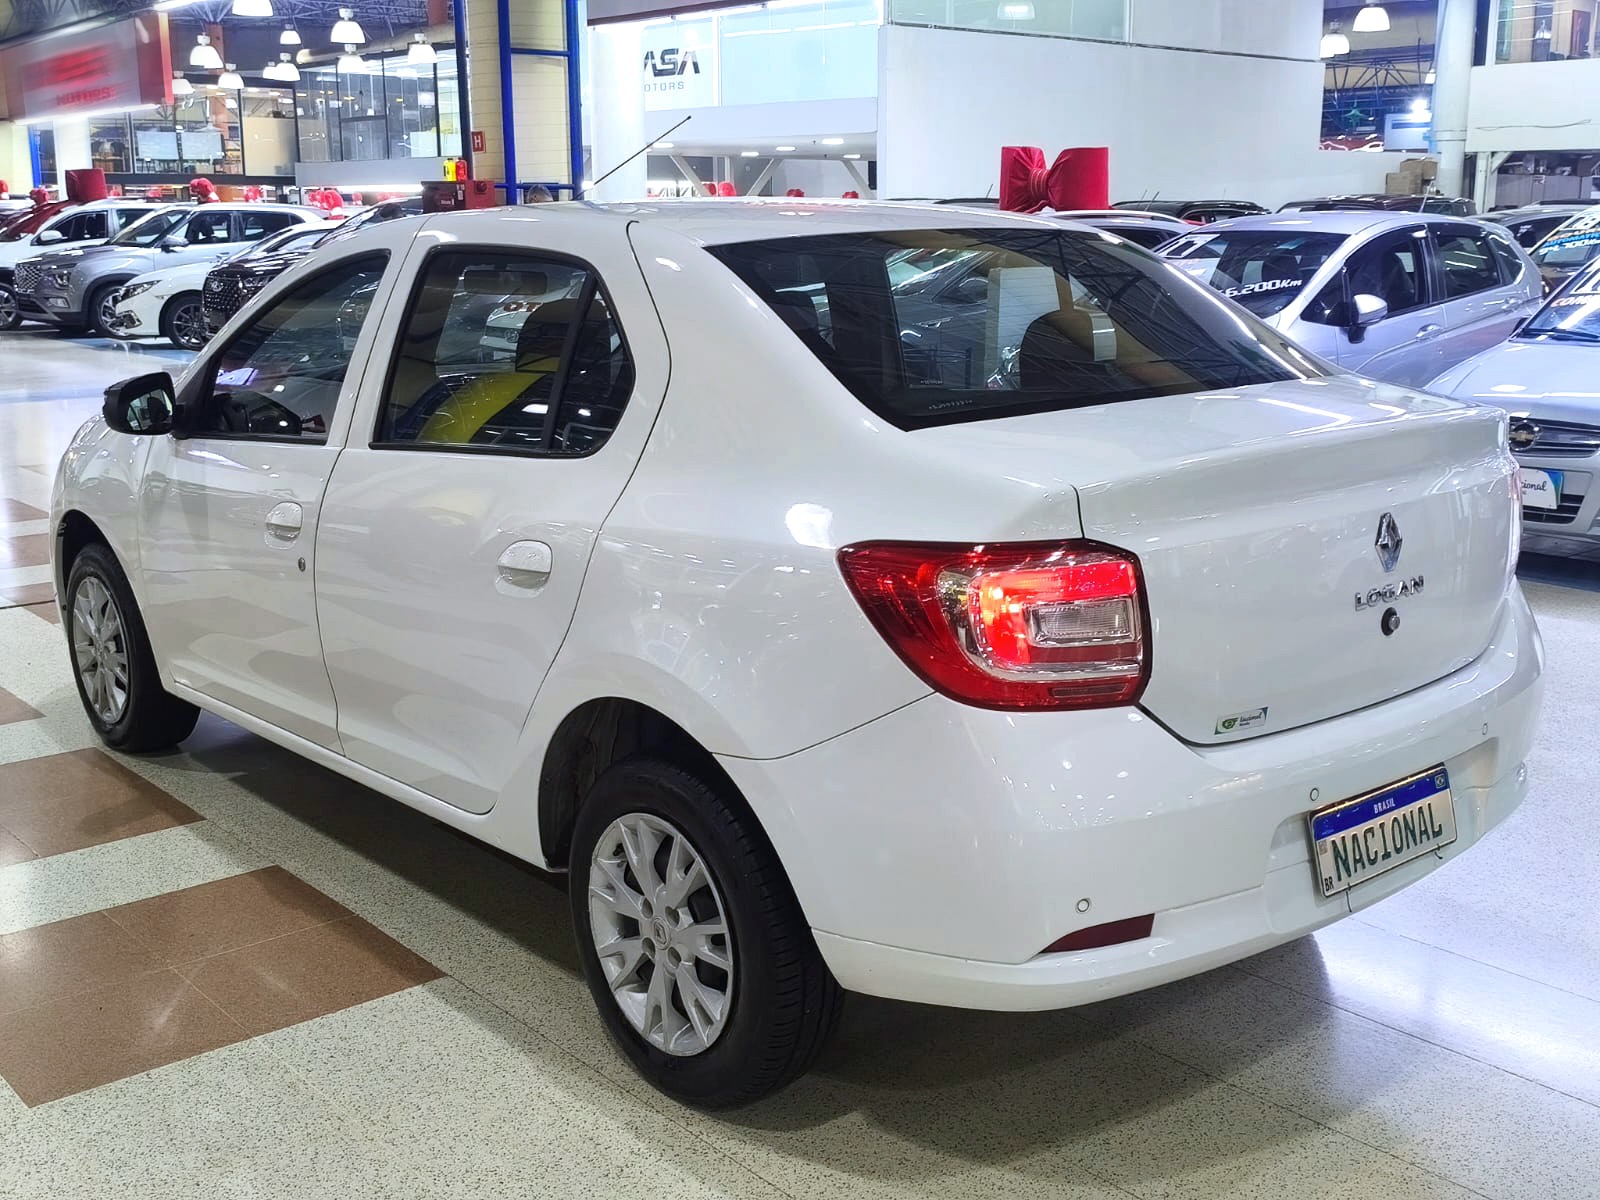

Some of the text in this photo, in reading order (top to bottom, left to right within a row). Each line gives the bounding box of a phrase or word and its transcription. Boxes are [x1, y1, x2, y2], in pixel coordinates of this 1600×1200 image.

[643, 48, 701, 77] ASA
[643, 81, 685, 92] OTORS
[1355, 575, 1424, 612] LOGAN
[1373, 797, 1396, 814] BRASIL
[1331, 802, 1443, 882] NACIONAL
[1324, 876, 1334, 892] BR
